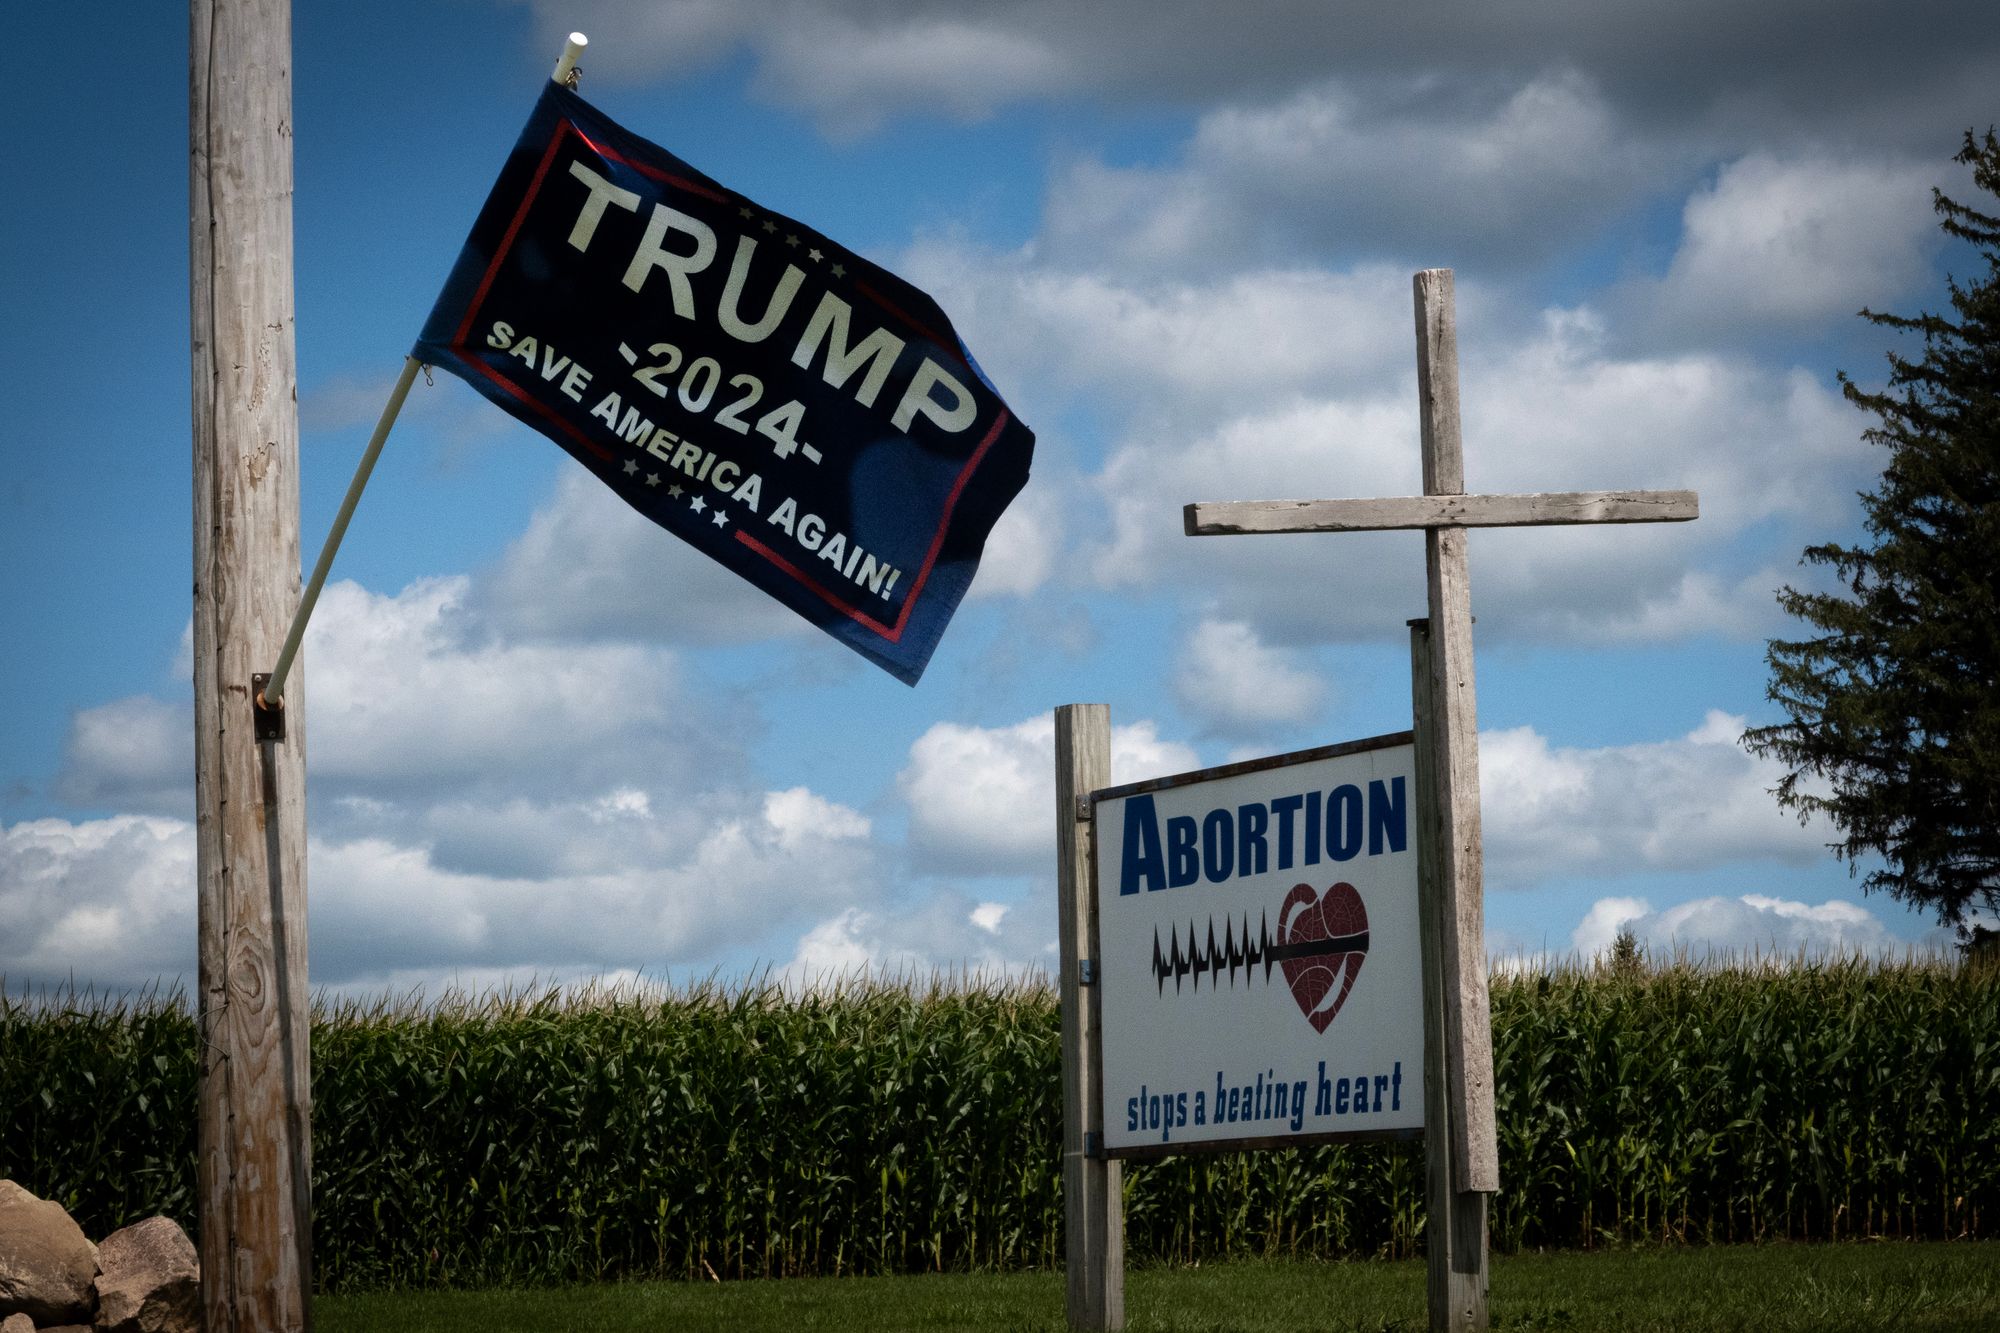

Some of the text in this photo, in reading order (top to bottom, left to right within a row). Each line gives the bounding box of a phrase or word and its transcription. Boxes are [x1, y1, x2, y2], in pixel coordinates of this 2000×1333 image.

[568, 159, 978, 437] TRUMP
[486, 320, 902, 601] SAVE AMERICA AGAIN!
[1120, 776, 1407, 896] ABORTION
[1127, 1061, 1402, 1141] stops a beating heart
